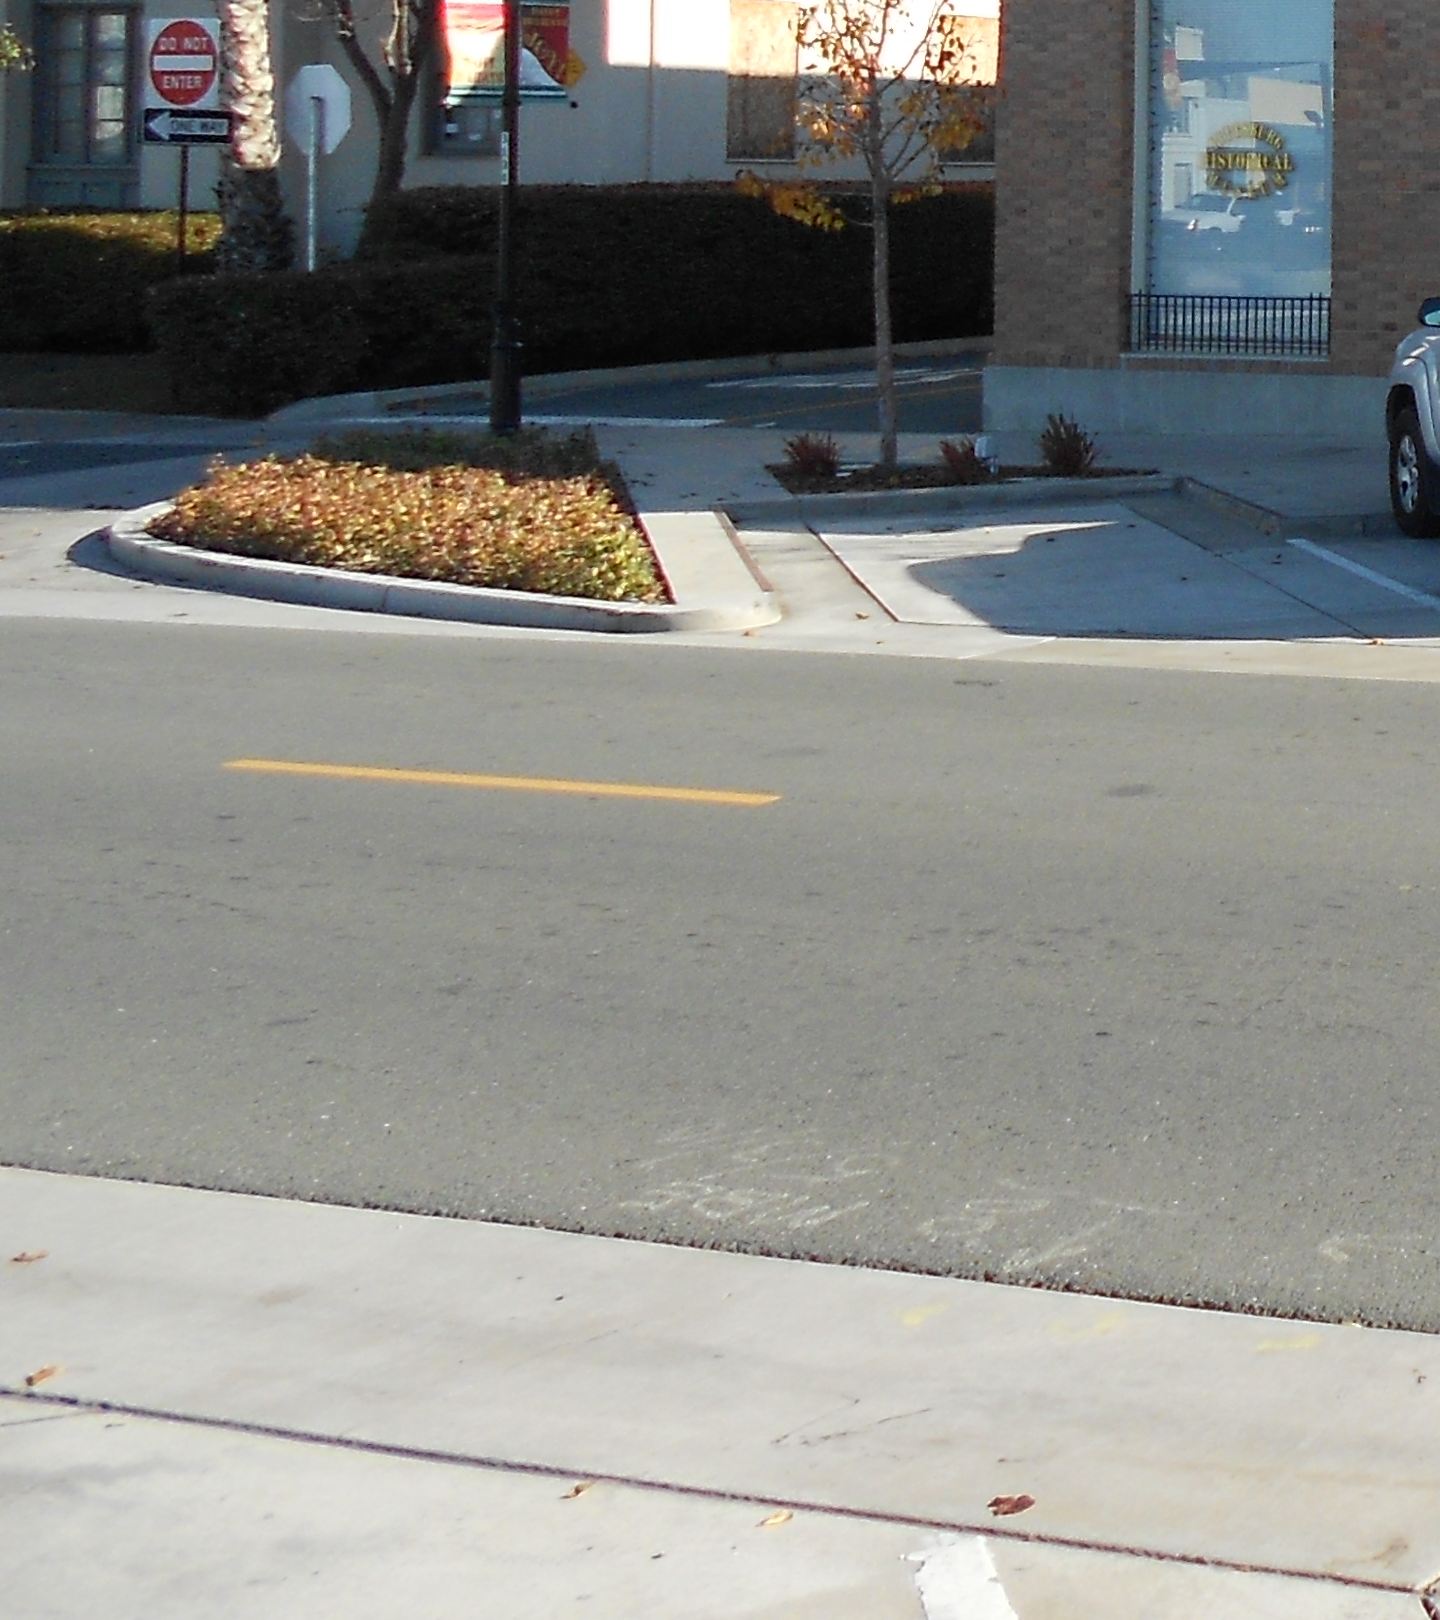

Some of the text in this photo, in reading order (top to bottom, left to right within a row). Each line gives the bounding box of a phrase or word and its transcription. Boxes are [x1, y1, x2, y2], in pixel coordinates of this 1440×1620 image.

[158, 37, 208, 50] DO NOT
[163, 75, 203, 89] ENTER
